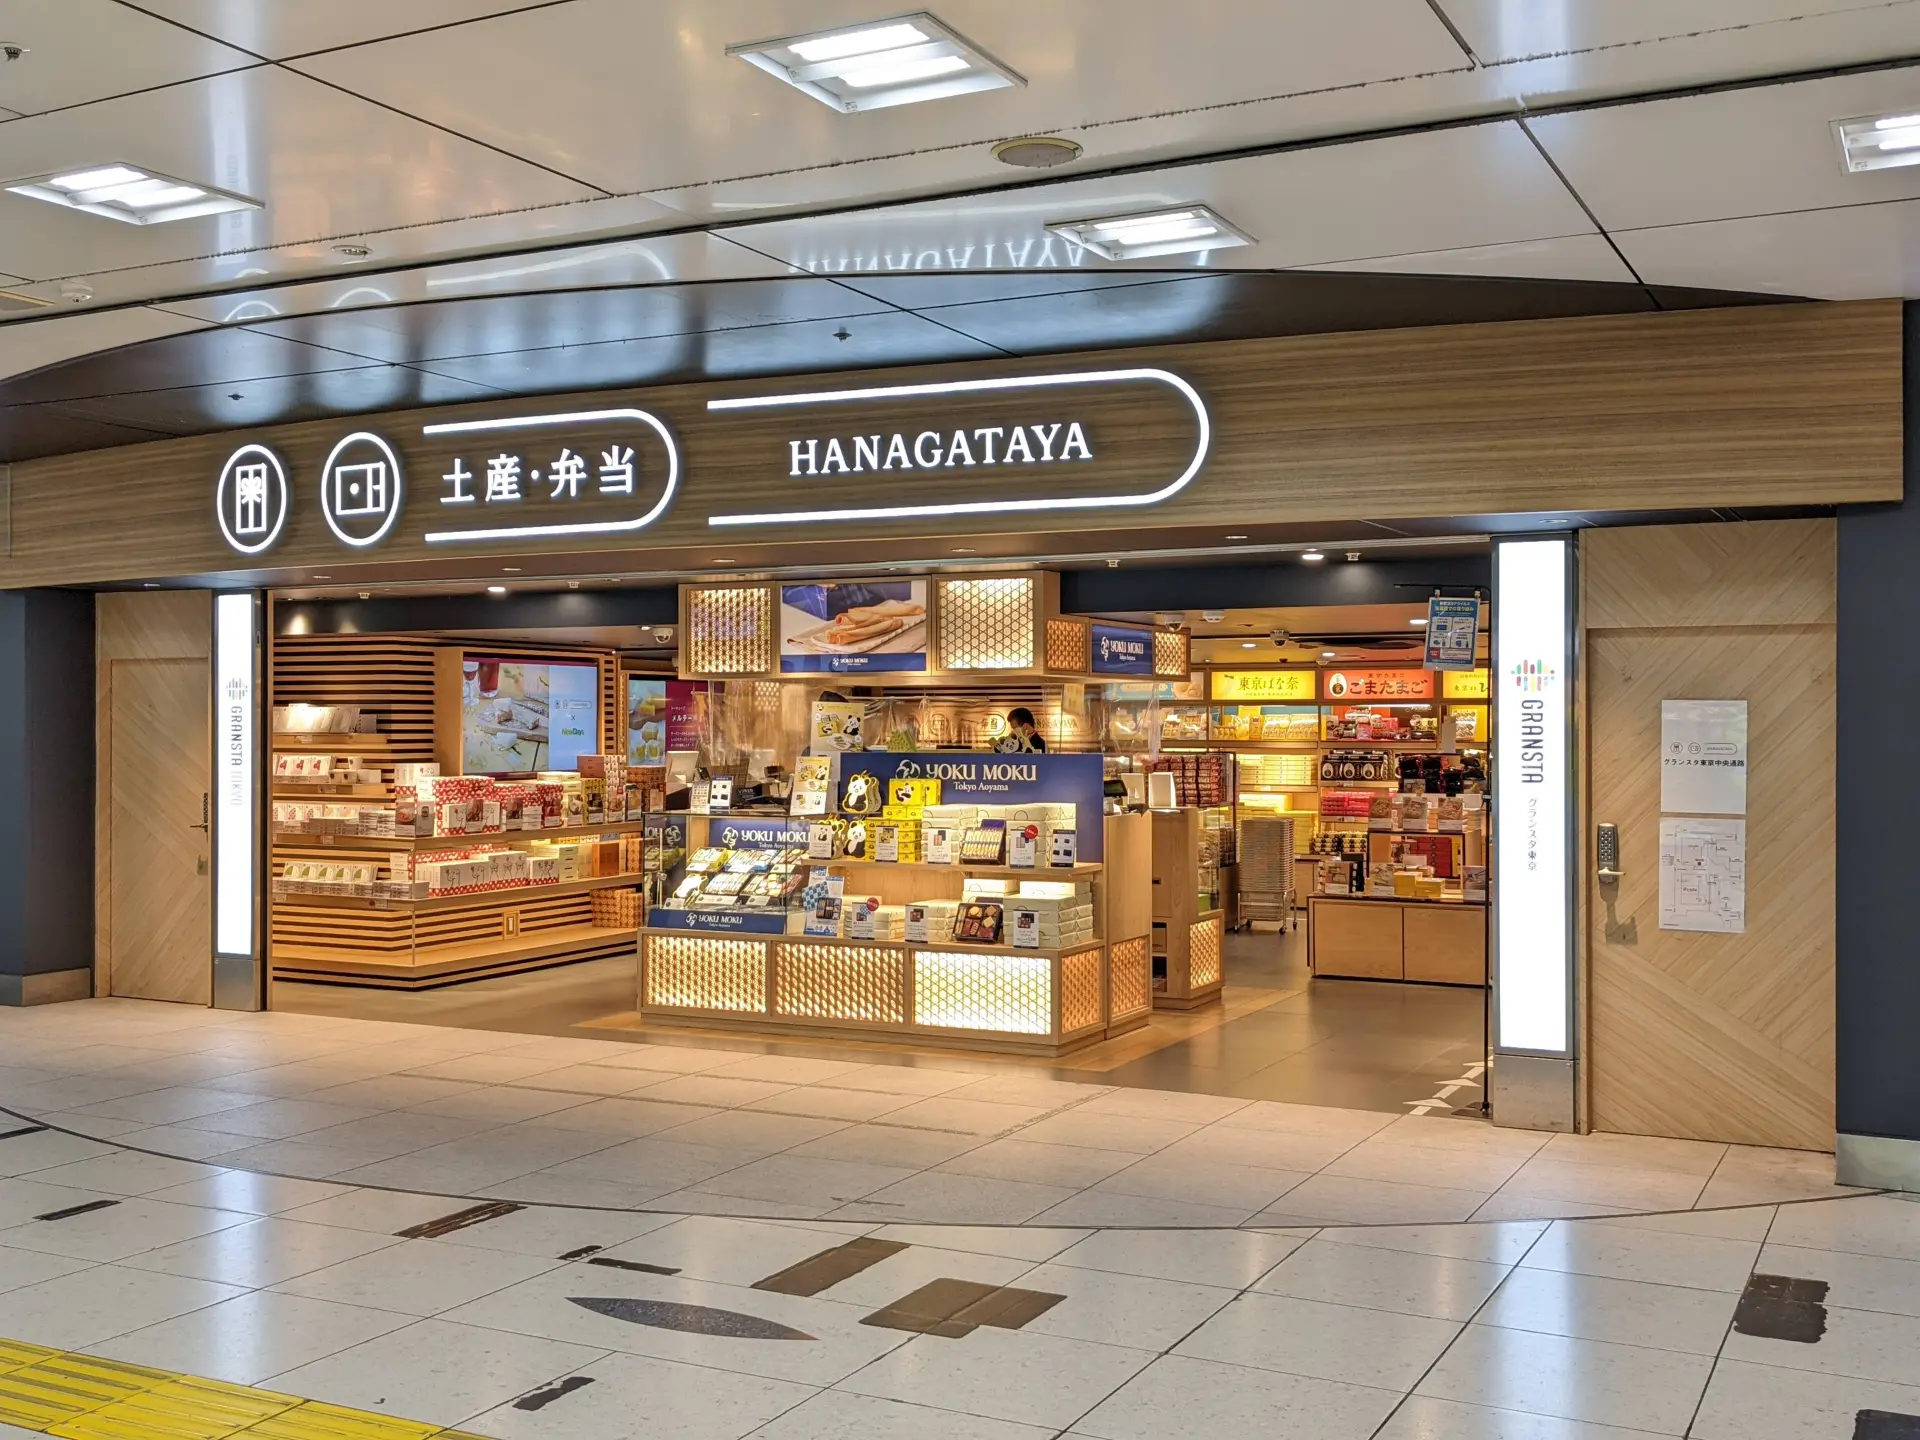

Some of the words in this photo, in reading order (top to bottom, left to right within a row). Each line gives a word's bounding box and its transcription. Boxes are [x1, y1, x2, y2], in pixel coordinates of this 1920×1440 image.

[788, 421, 1093, 477] HANAGATAYA
[440, 444, 636, 503] 土産・弁当
[1110, 640, 1127, 652] YOKU
[1127, 642, 1144, 655] MOKU
[1238, 676, 1299, 691] 東京ばな奈
[1350, 679, 1428, 695] ごまたまご
[230, 706, 243, 766] GRANSTA
[1521, 699, 1544, 784] GRANSTA
[925, 763, 976, 781] YOKU
[982, 764, 1037, 781] MOKU
[953, 781, 977, 793] Tokyo
[978, 781, 1009, 793] Aoyama
[741, 829, 773, 843] YOKU
[776, 830, 811, 844] MOKU
[1528, 798, 1538, 871] グランスタ東京
[698, 914, 719, 923] YOKU
[721, 915, 743, 924] MOKU
